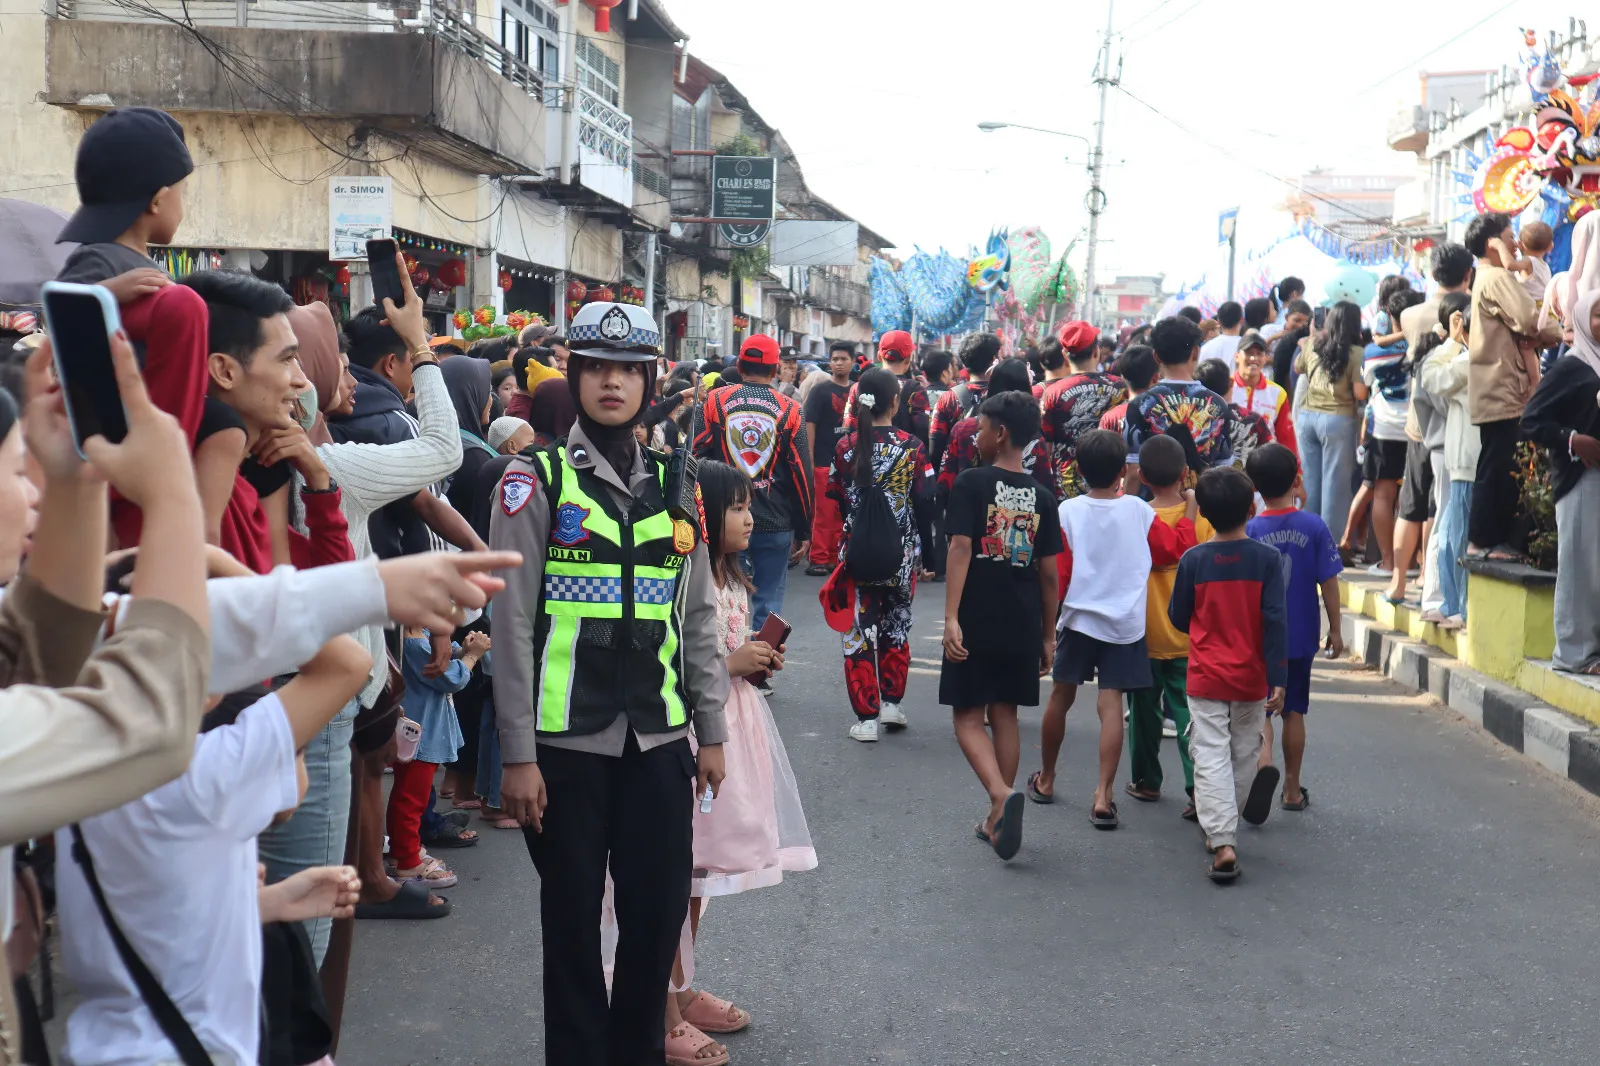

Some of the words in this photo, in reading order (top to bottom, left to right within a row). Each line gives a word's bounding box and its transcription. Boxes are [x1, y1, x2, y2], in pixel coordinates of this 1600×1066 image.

[334, 186, 347, 194] dr.
[350, 186, 384, 194] SIMON
[1061, 384, 1099, 402] SAHABAT
[722, 398, 745, 413] FIRE
[747, 397, 784, 418] RESCUE
[551, 548, 588, 561] DIAN
